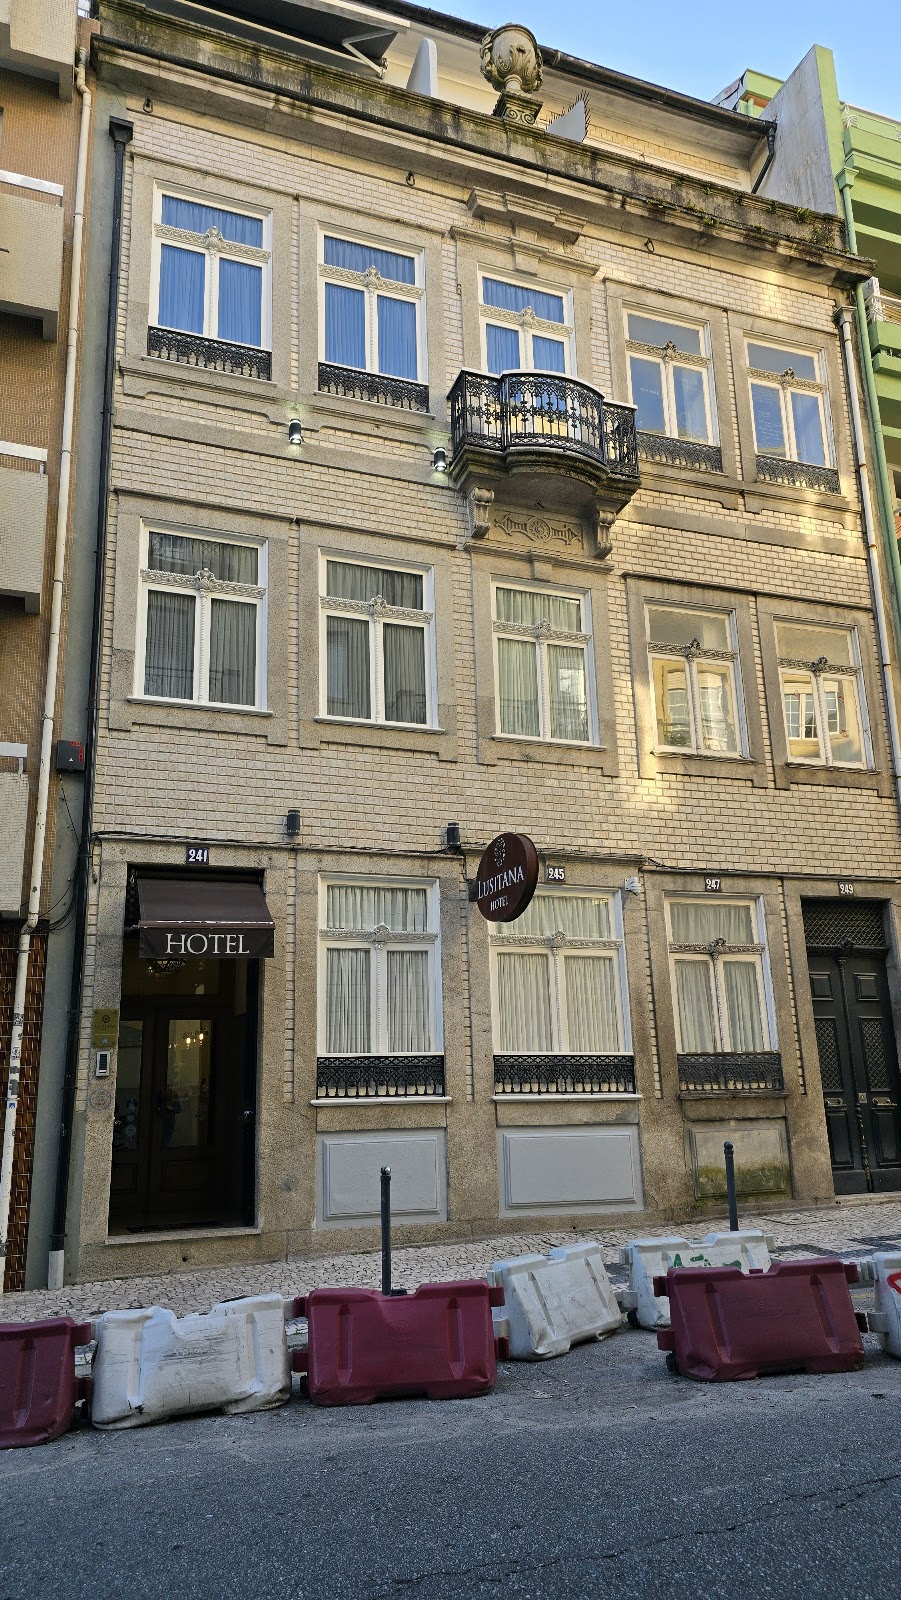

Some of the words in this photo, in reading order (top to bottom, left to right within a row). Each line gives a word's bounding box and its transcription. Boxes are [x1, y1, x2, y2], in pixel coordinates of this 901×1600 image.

[188, 848, 208, 862] 241
[548, 867, 565, 880] 245
[477, 865, 525, 900] LUSITANA
[705, 878, 721, 890] 247
[840, 883, 854, 895] 249
[490, 895, 509, 911] HOTEL
[165, 933, 250, 955] HOTEL
